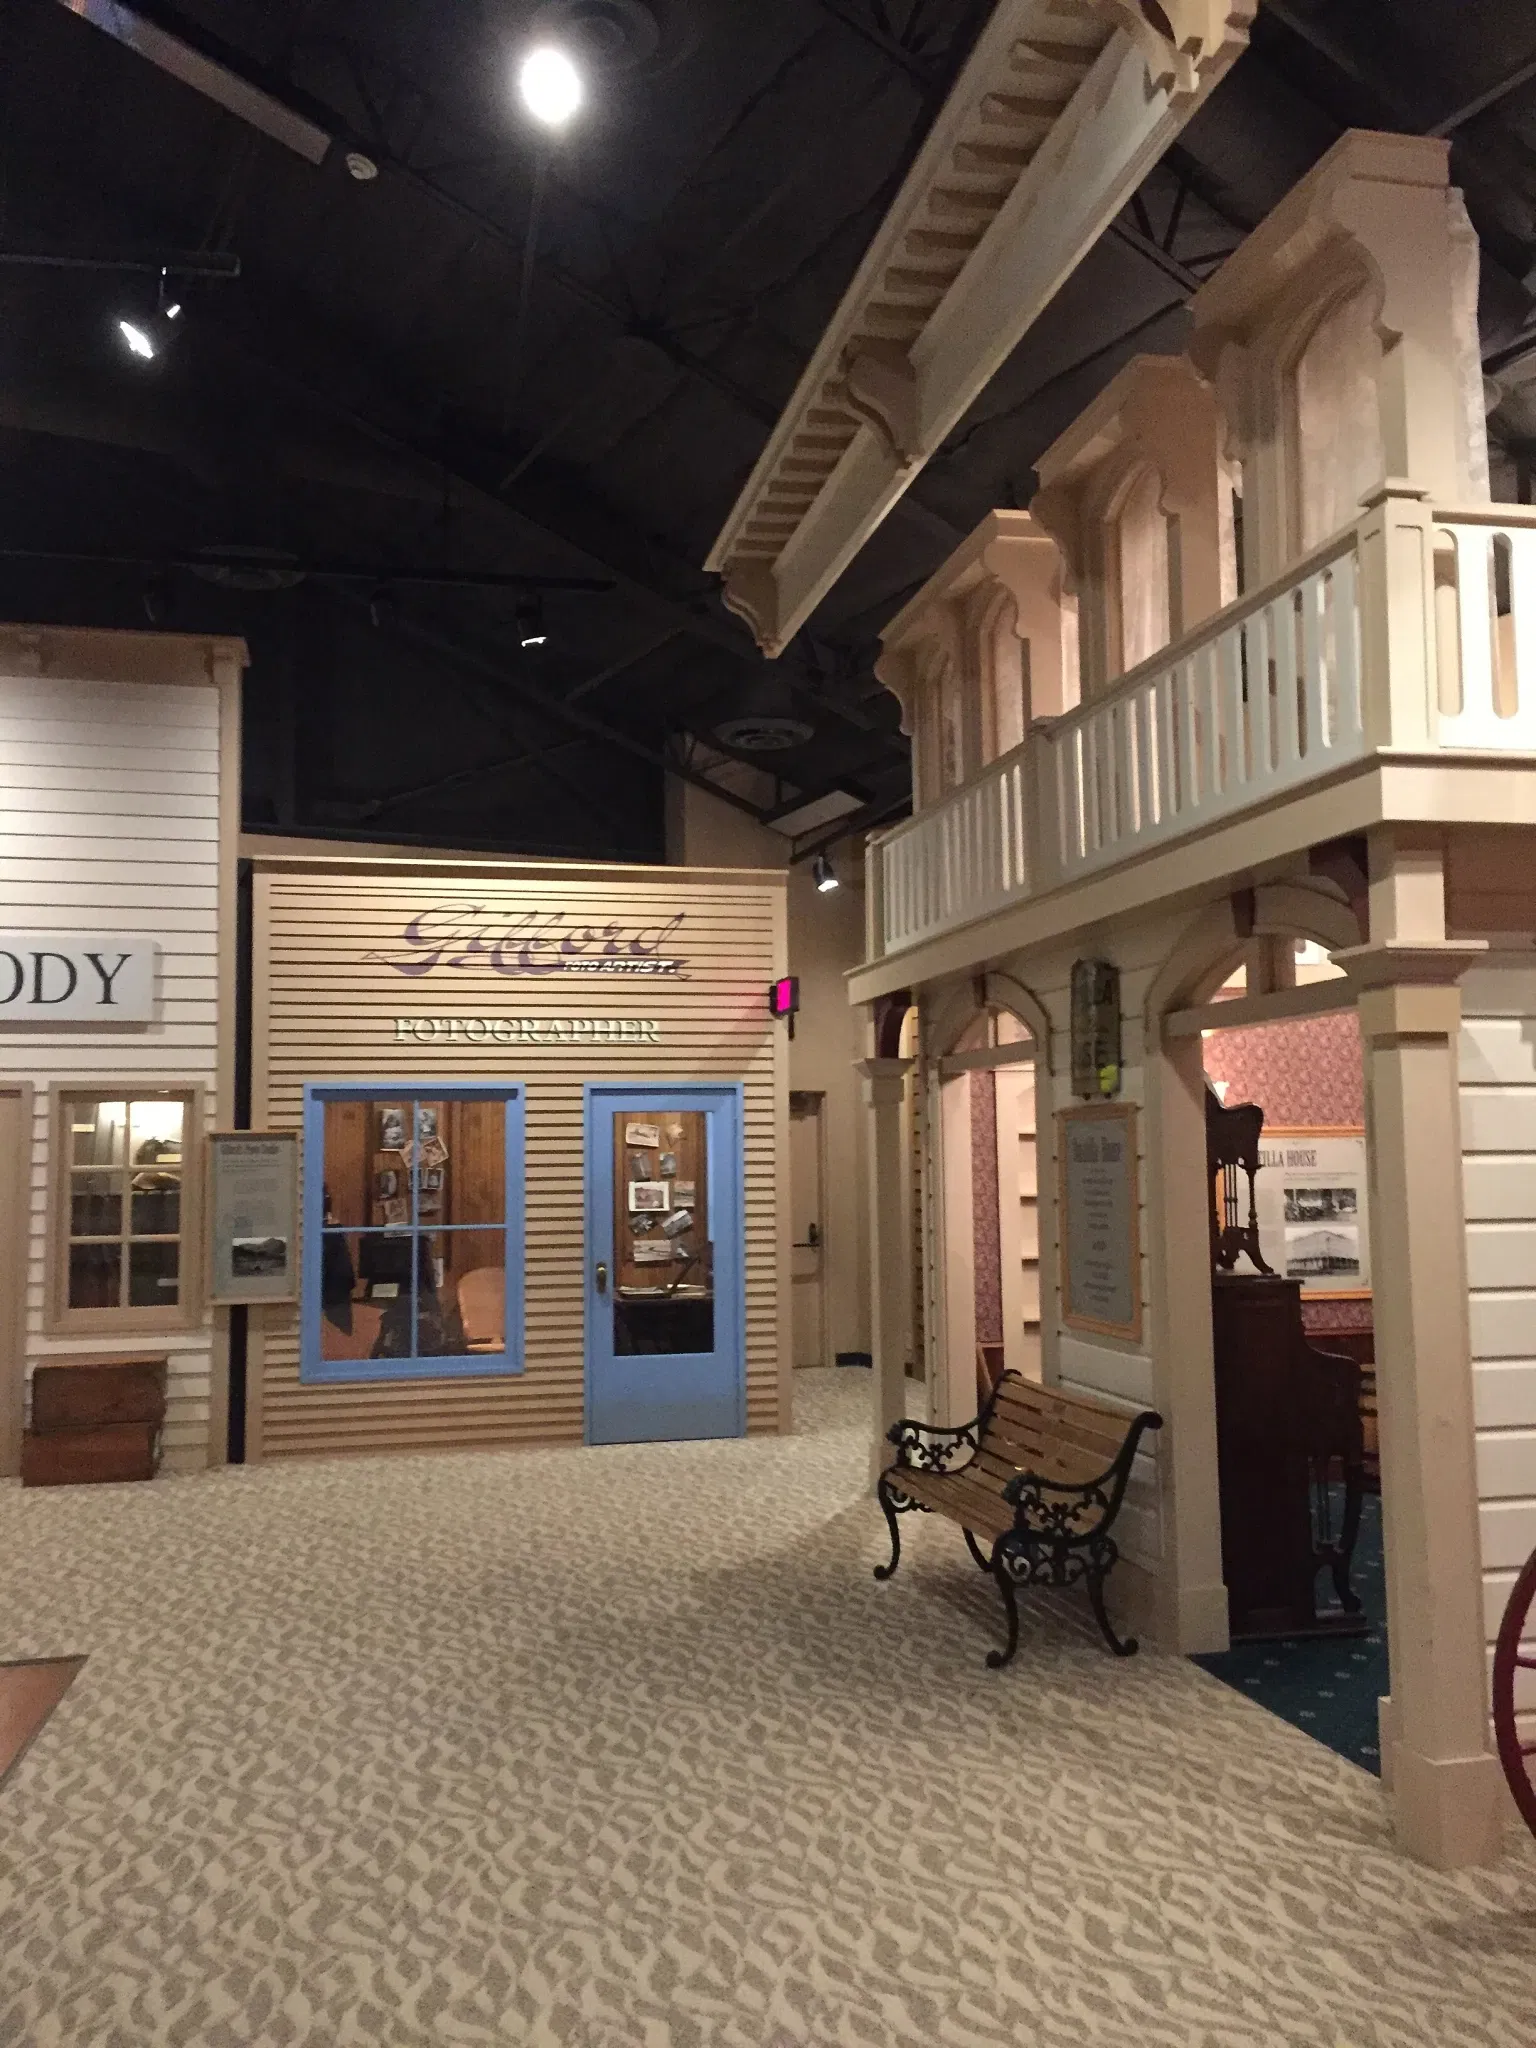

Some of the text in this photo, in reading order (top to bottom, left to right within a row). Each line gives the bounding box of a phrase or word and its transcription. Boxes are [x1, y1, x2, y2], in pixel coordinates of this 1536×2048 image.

[362, 903, 685, 976] Gifford
[392, 1017, 660, 1043] FOTOGRAPHER
[1286, 1149, 1317, 1167] HOUSE
